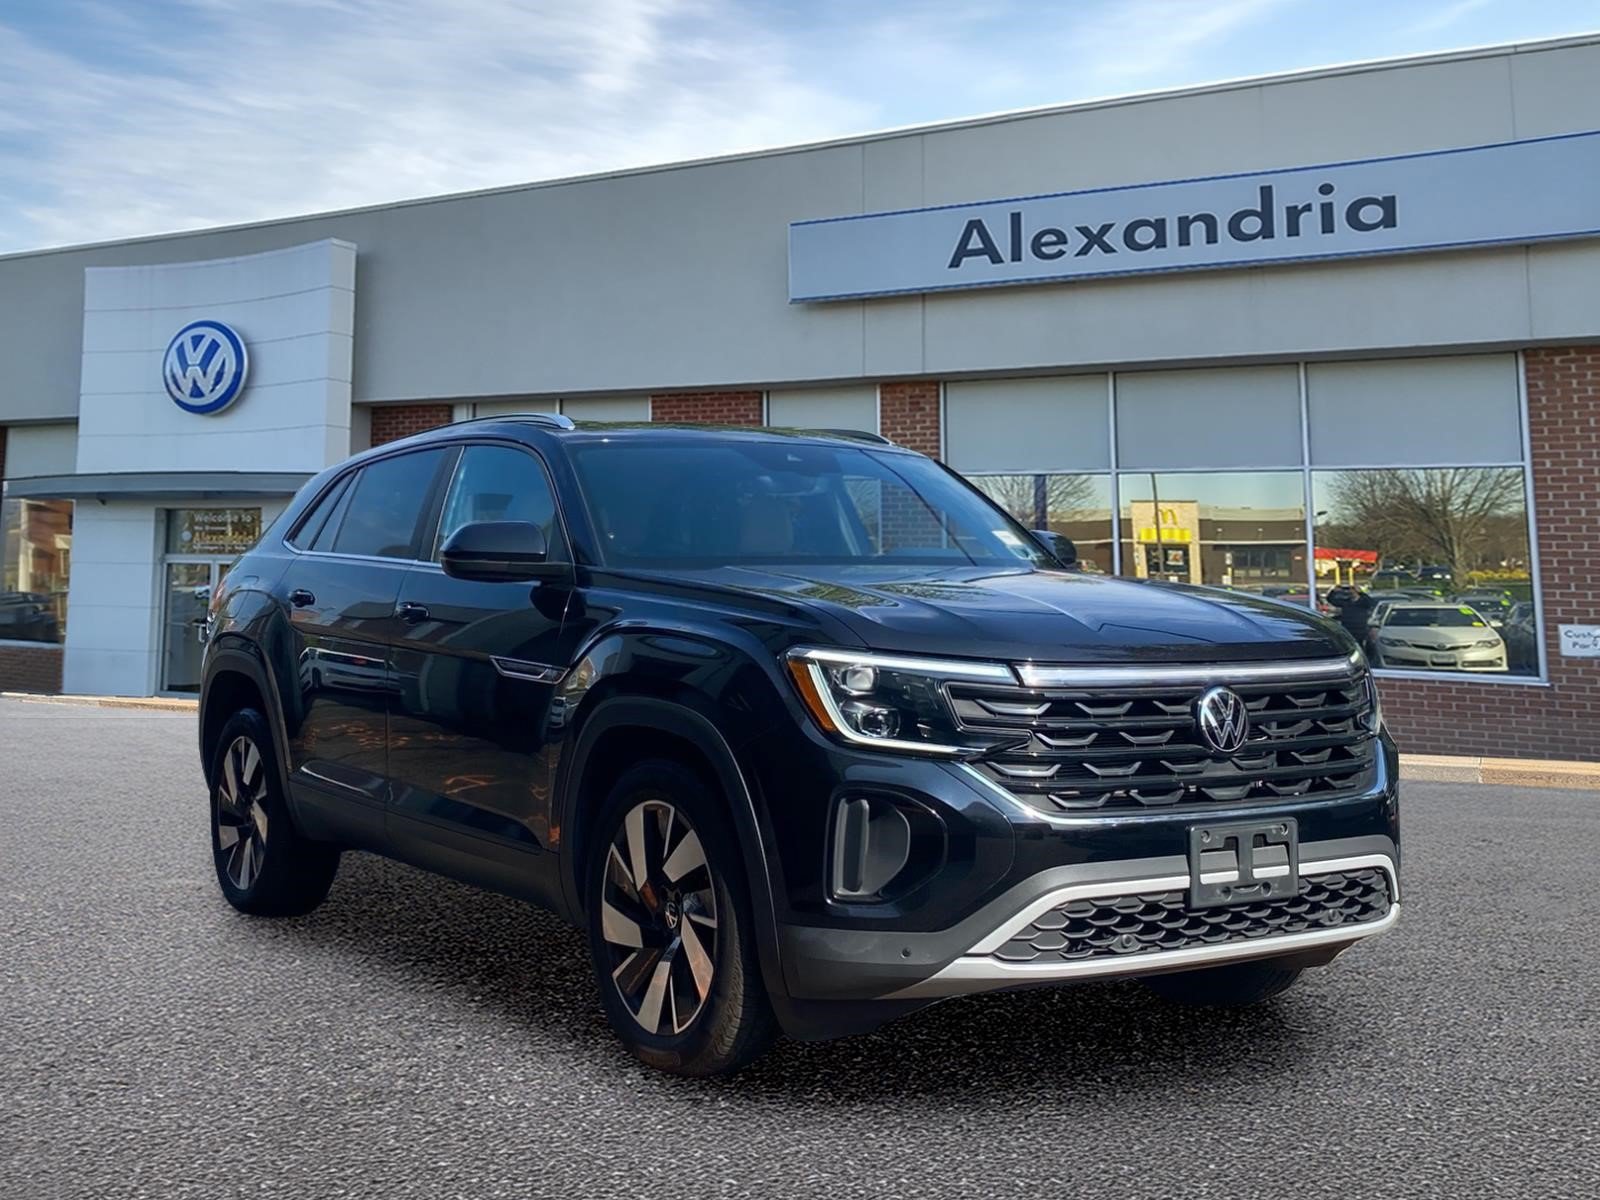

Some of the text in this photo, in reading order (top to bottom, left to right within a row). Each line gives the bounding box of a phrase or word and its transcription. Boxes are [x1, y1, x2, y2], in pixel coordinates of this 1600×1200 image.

[947, 182, 1398, 269] Alexandria
[168, 327, 236, 404] VW
[1202, 689, 1247, 750] VW
